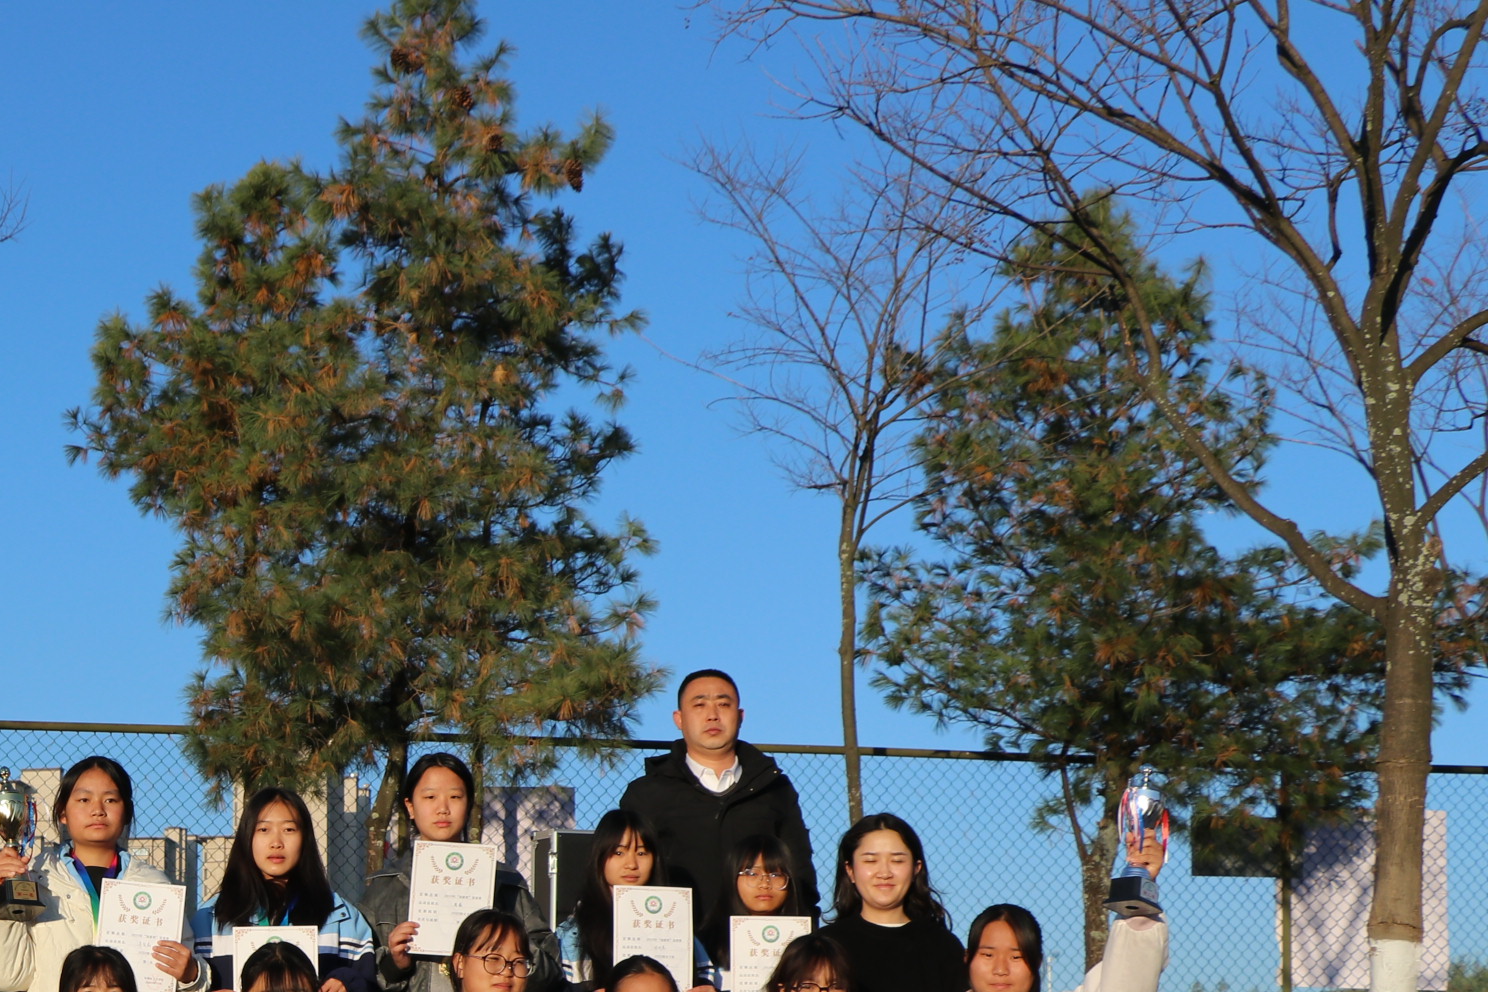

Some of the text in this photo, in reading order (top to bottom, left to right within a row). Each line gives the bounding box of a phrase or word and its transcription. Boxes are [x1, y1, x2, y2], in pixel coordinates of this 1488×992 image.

[431, 875, 475, 886] 获奖证书
[119, 914, 163, 926] 获奖证书
[633, 919, 675, 929] 获奖证书
